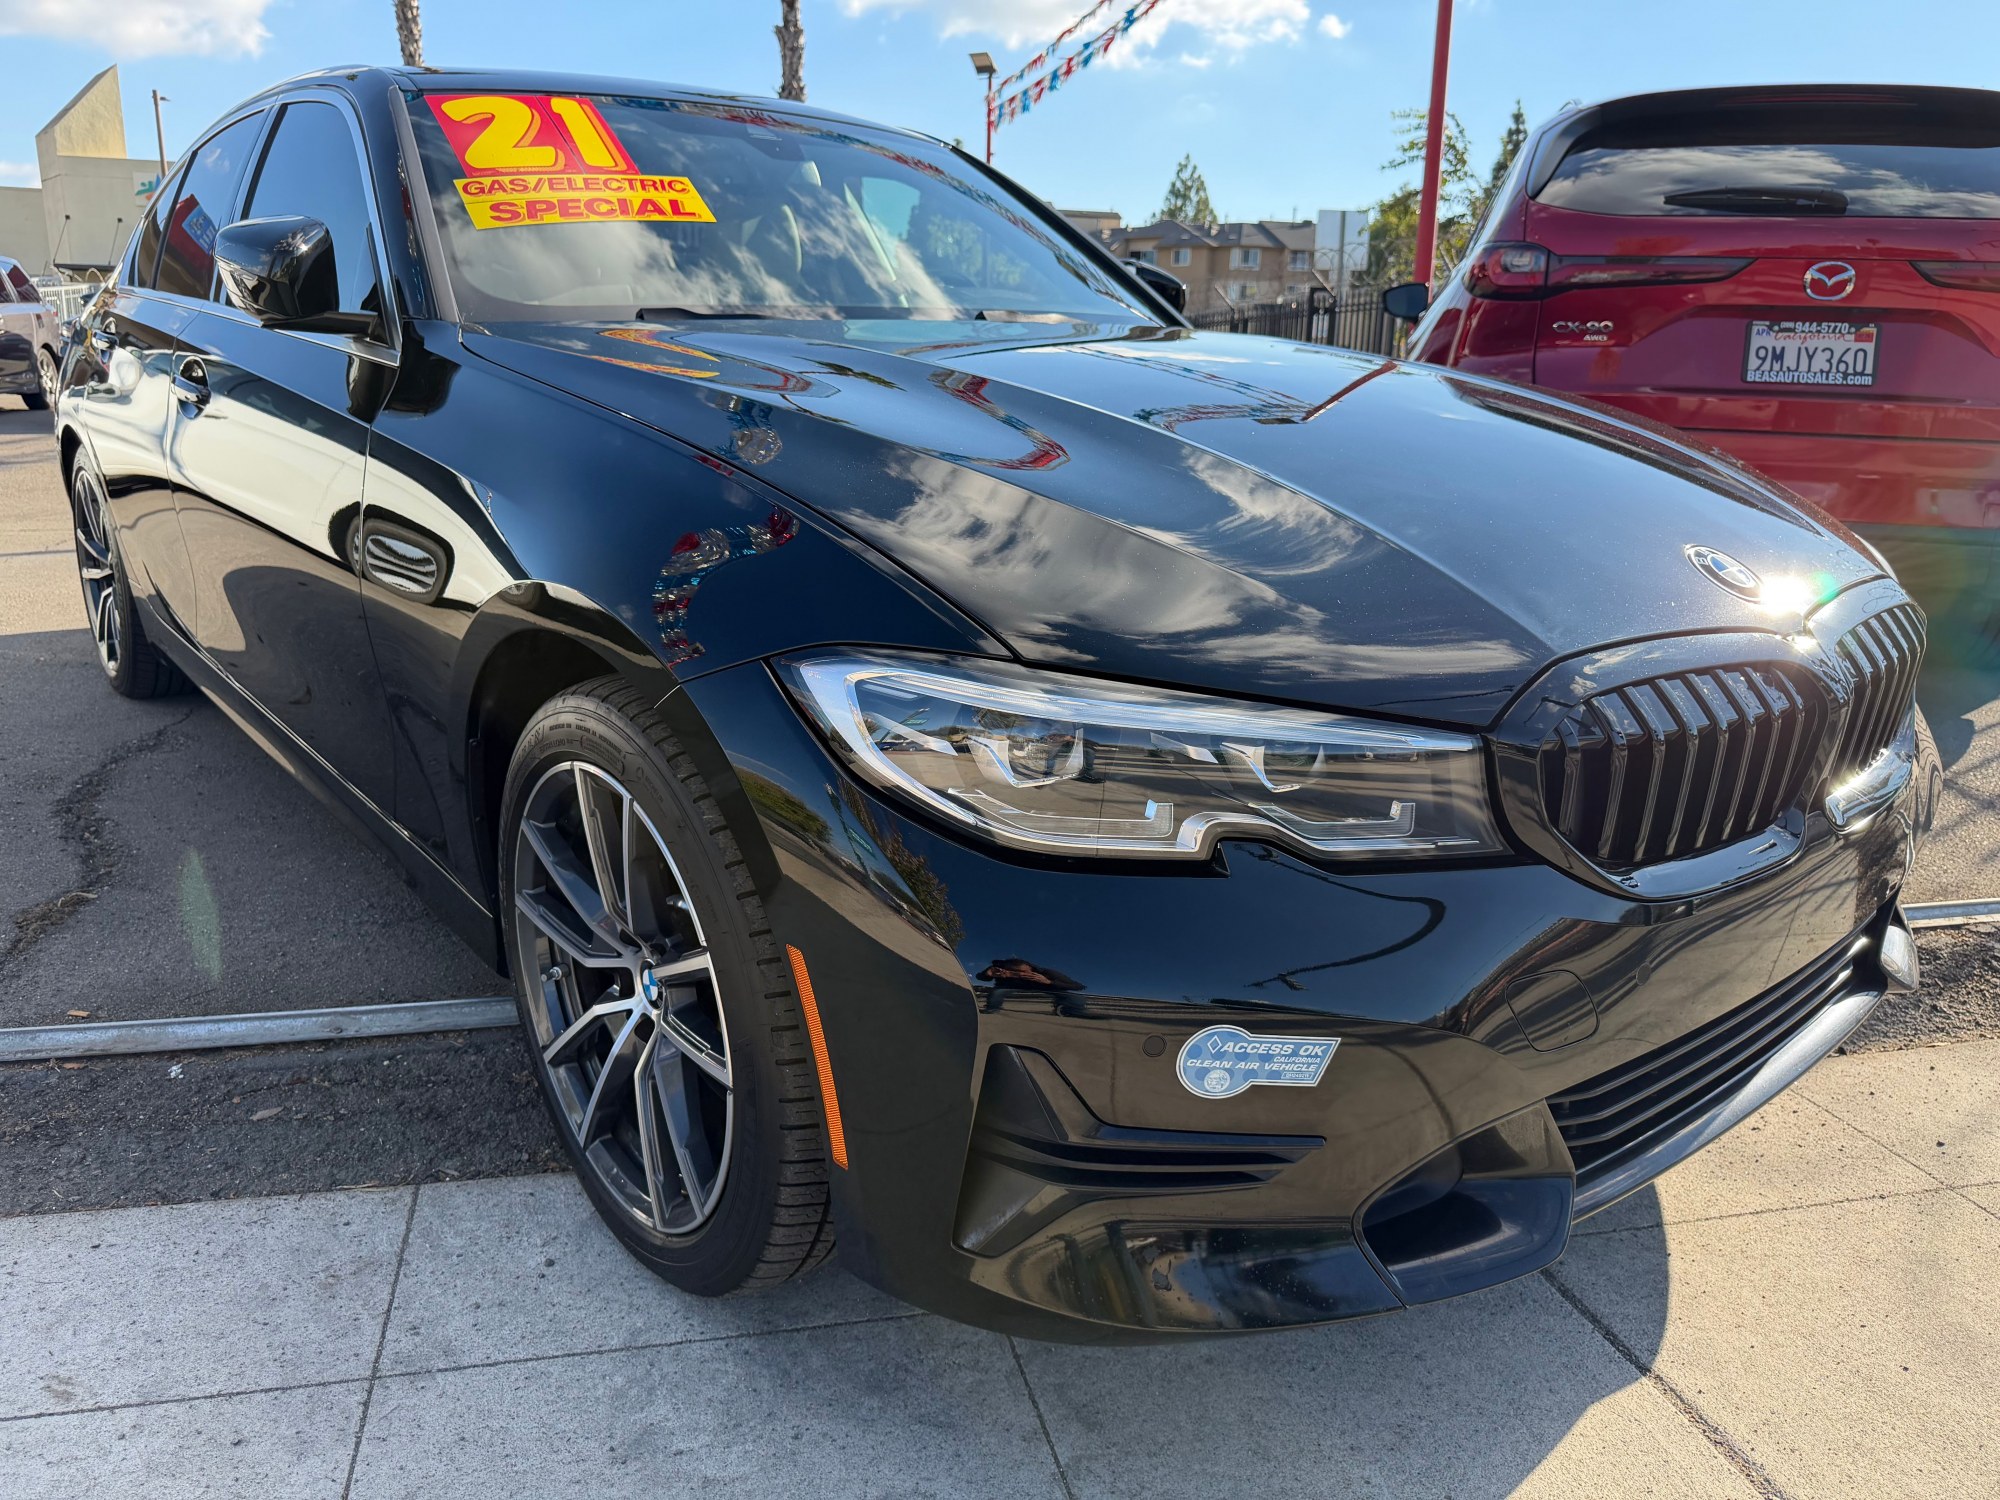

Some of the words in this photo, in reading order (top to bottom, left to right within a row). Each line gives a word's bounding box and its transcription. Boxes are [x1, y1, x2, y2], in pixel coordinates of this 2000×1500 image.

[441, 96, 624, 171] 21
[462, 177, 690, 197] GAS/ELECTRIC
[489, 197, 700, 223] SPECIAL
[1552, 321, 1613, 333] CX-90
[1795, 321, 1849, 333] 944-5770
[1755, 345, 1868, 374] 9MJY360
[1747, 371, 1872, 385] BEASAUTOSALES.com
[1220, 1041, 1294, 1055] ACCESS
[1298, 1045, 1328, 1056] OK
[1186, 1059, 1232, 1069] CLEAN
[1235, 1062, 1260, 1070] AIR
[1264, 1063, 1319, 1072] VEHICLE
[1273, 1056, 1321, 1064] CALIFORNIA
